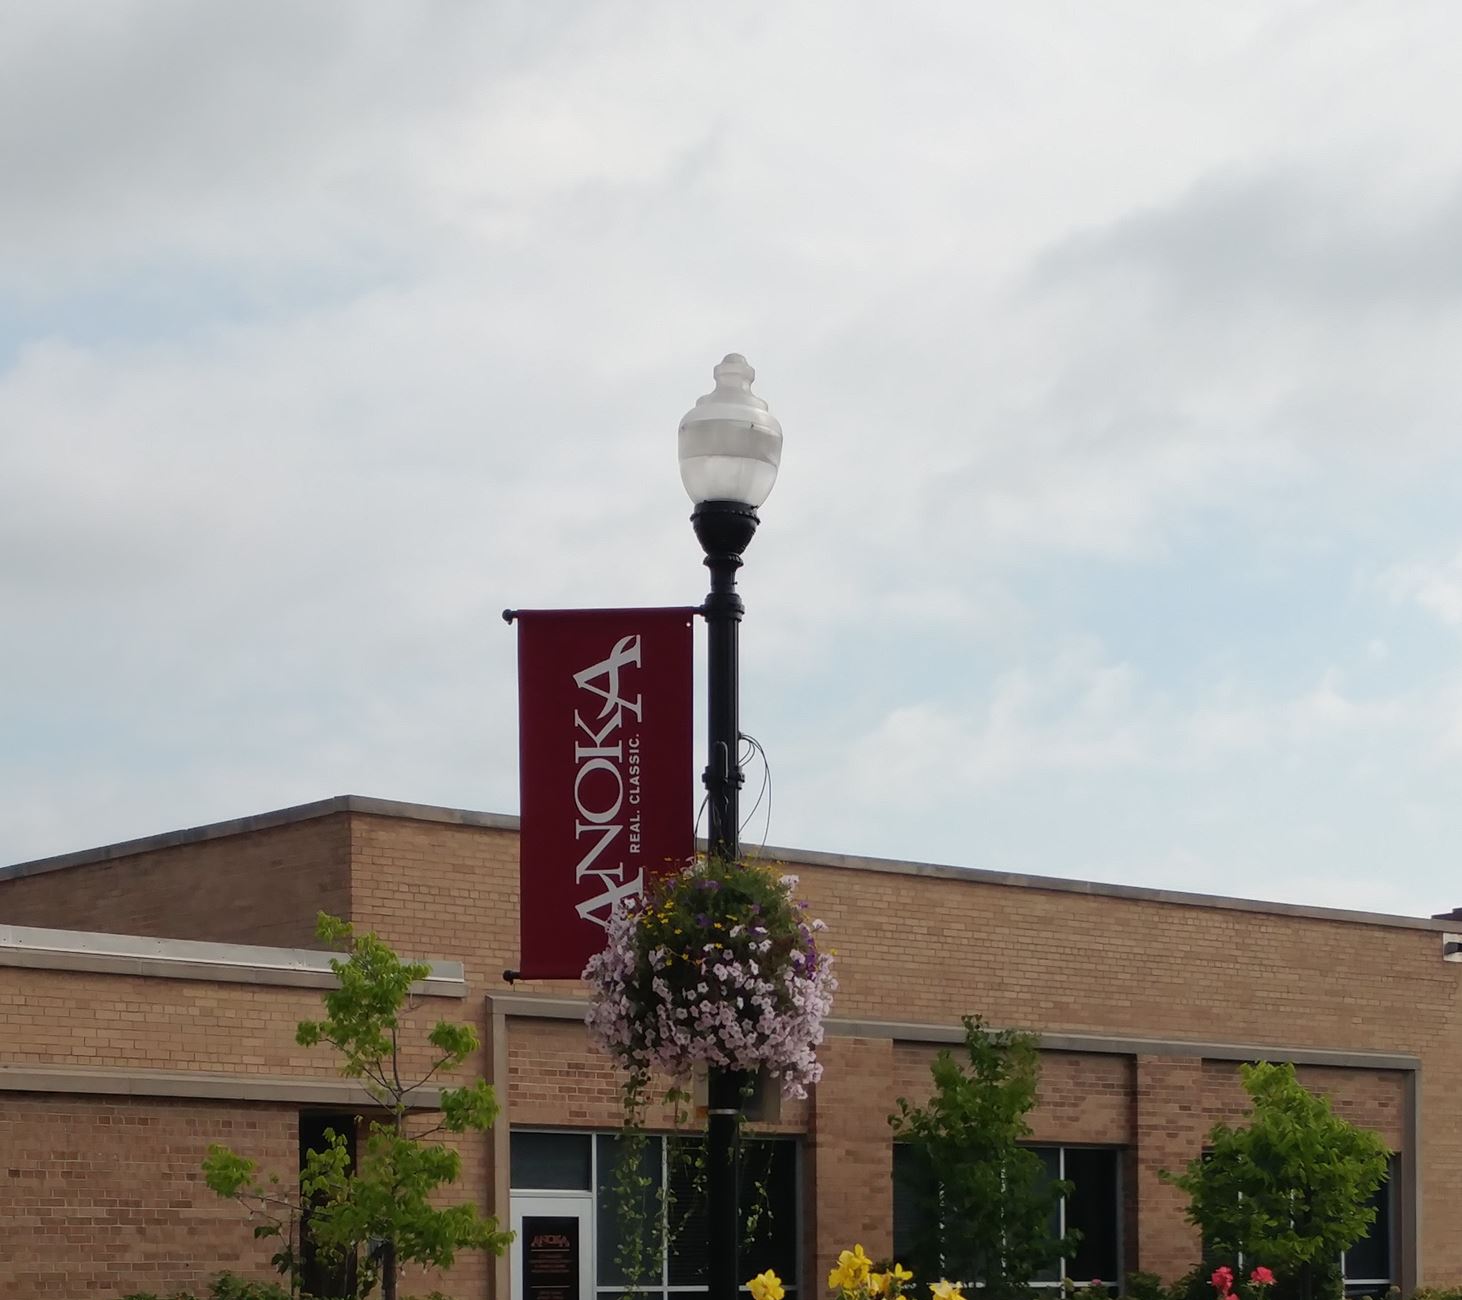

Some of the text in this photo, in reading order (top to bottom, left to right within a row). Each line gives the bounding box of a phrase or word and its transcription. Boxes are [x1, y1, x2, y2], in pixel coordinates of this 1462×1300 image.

[573, 634, 643, 929] ANOKA
[629, 733, 641, 853] REAL. CLASSIC.
